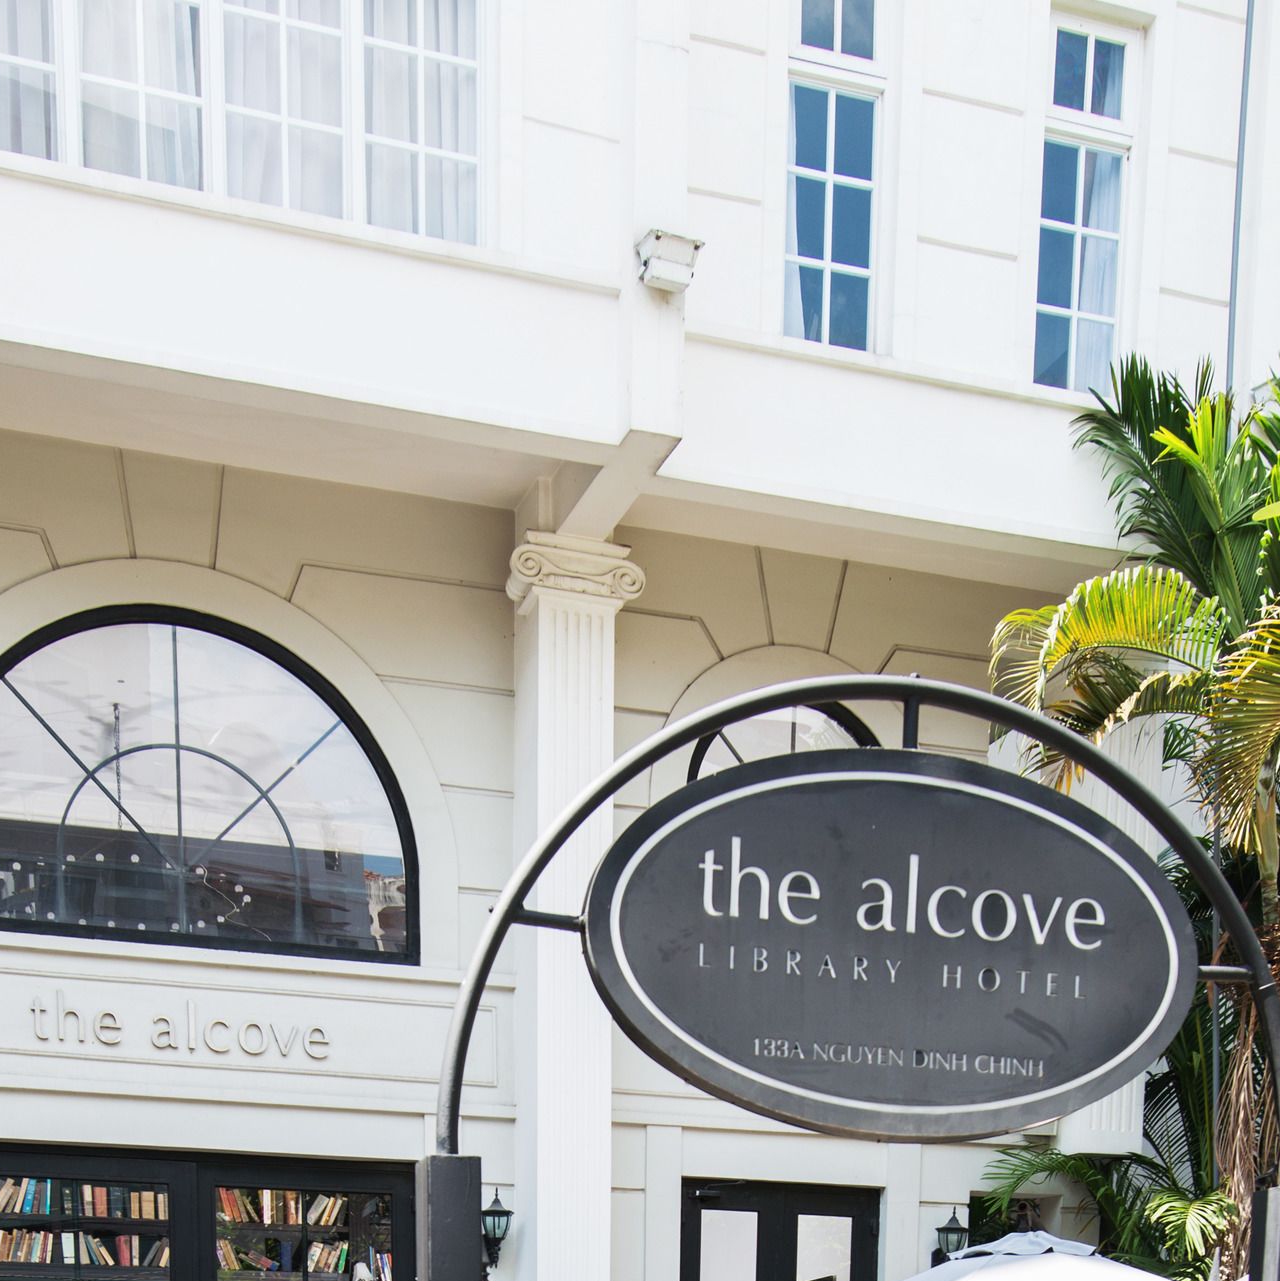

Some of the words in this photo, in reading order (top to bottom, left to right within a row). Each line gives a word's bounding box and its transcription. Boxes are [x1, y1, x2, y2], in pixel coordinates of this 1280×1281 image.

[698, 835, 821, 926] the
[856, 853, 1107, 951] alcove
[698, 942, 902, 984] LIBRARY
[941, 964, 1088, 1000] HOTEL
[30, 989, 123, 1046] the
[150, 999, 331, 1060] alcove
[753, 1037, 805, 1060] 133A
[812, 1042, 904, 1068] NGUYEN
[912, 1049, 968, 1073] DINH
[974, 1054, 1044, 1078] CHINH
